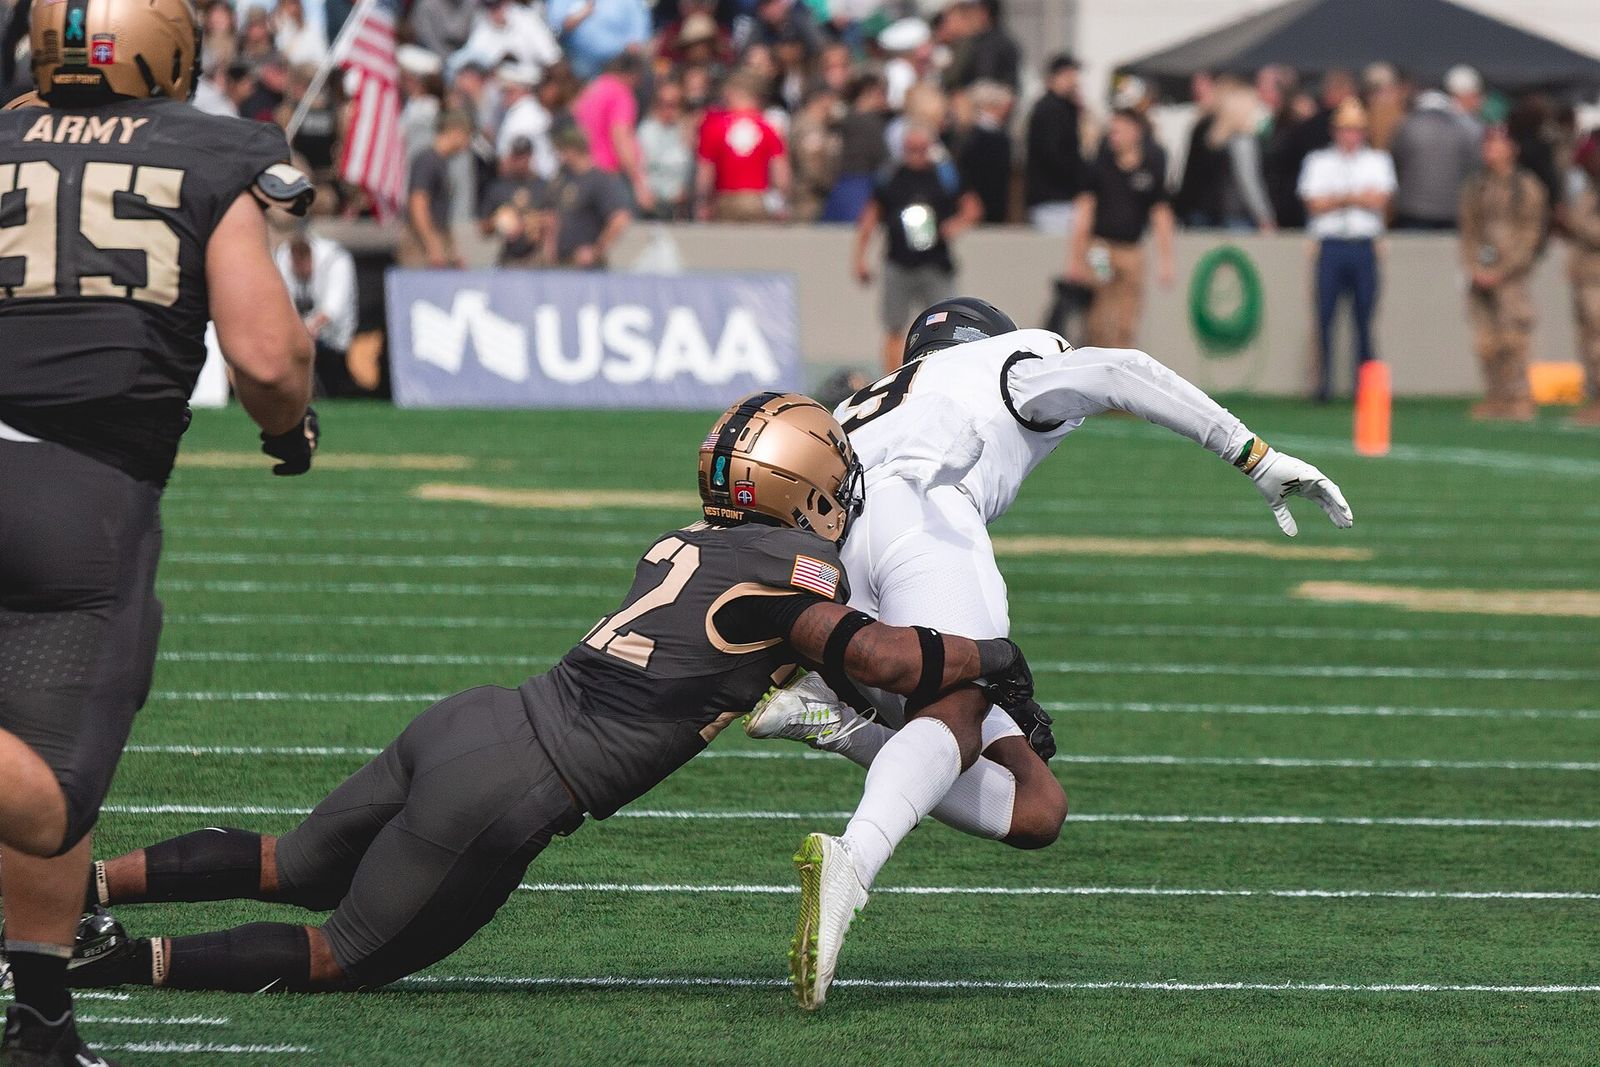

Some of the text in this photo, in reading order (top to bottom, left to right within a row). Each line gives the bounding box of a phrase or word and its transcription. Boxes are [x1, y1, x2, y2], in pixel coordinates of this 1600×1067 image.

[23, 115, 149, 144] ARMY
[533, 303, 780, 385] USAA
[704, 506, 744, 520] WEST POINT
[580, 536, 701, 669] 2
